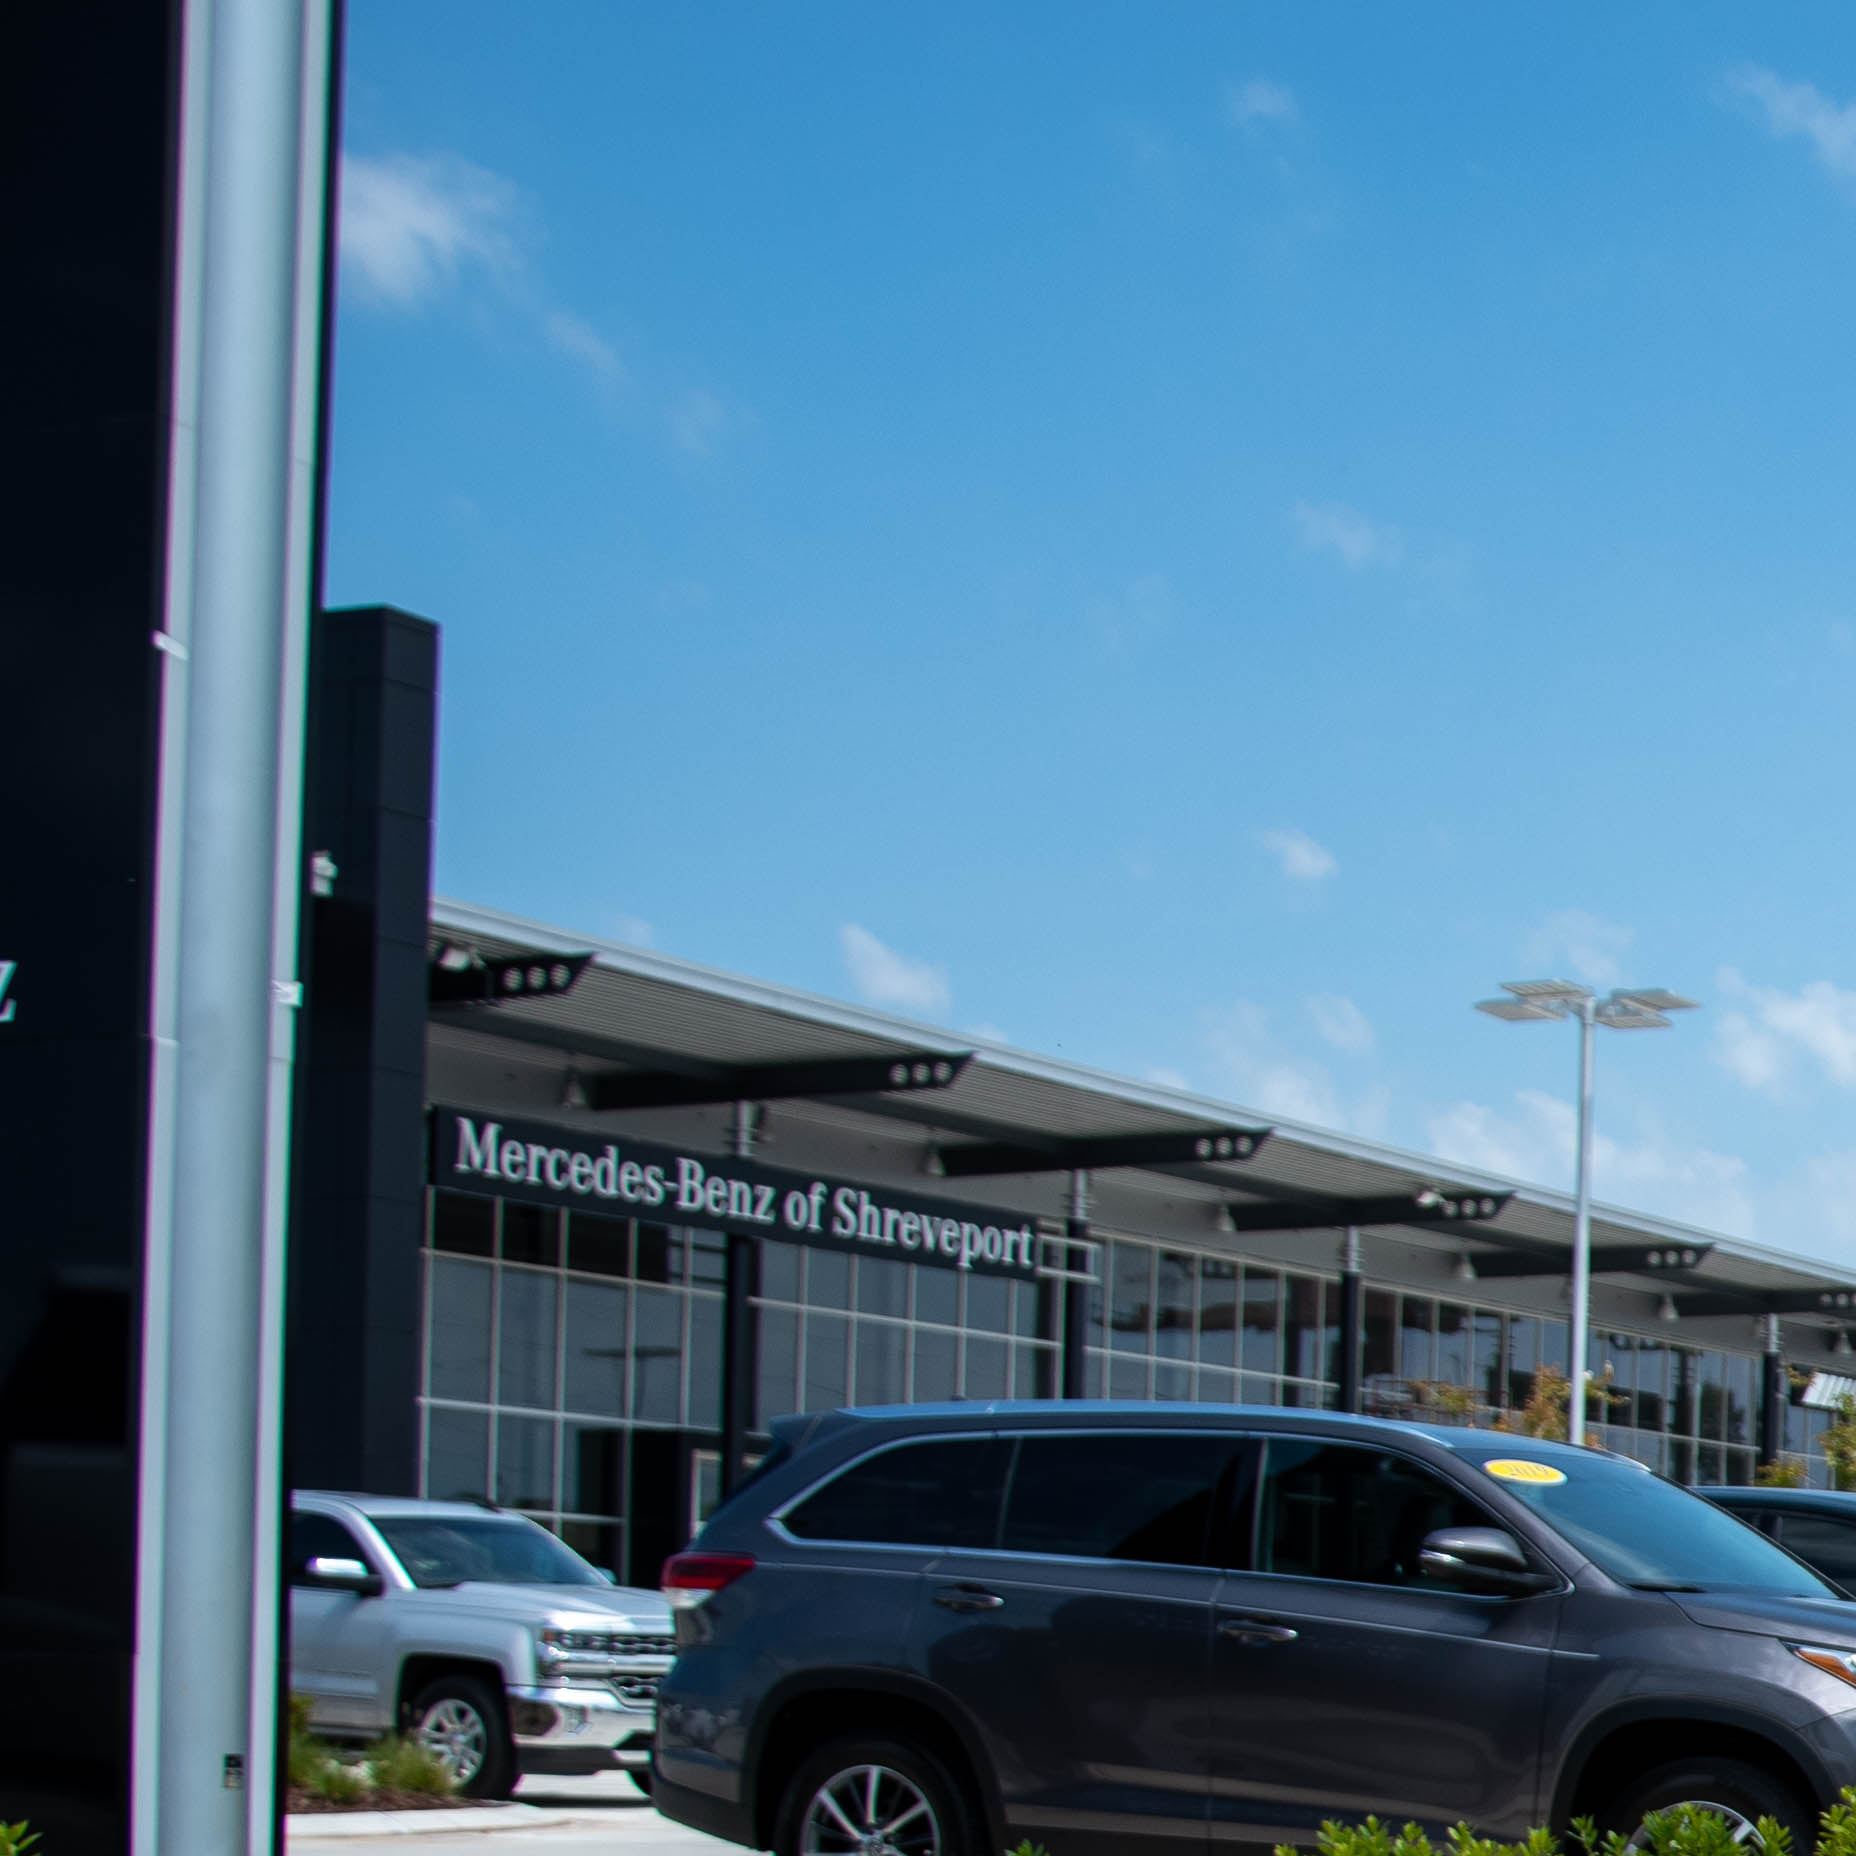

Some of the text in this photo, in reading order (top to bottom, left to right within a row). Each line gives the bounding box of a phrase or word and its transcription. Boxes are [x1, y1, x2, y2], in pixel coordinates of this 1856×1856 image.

[453, 1116, 1034, 1270] Mercedes-Benz of Shreveport
